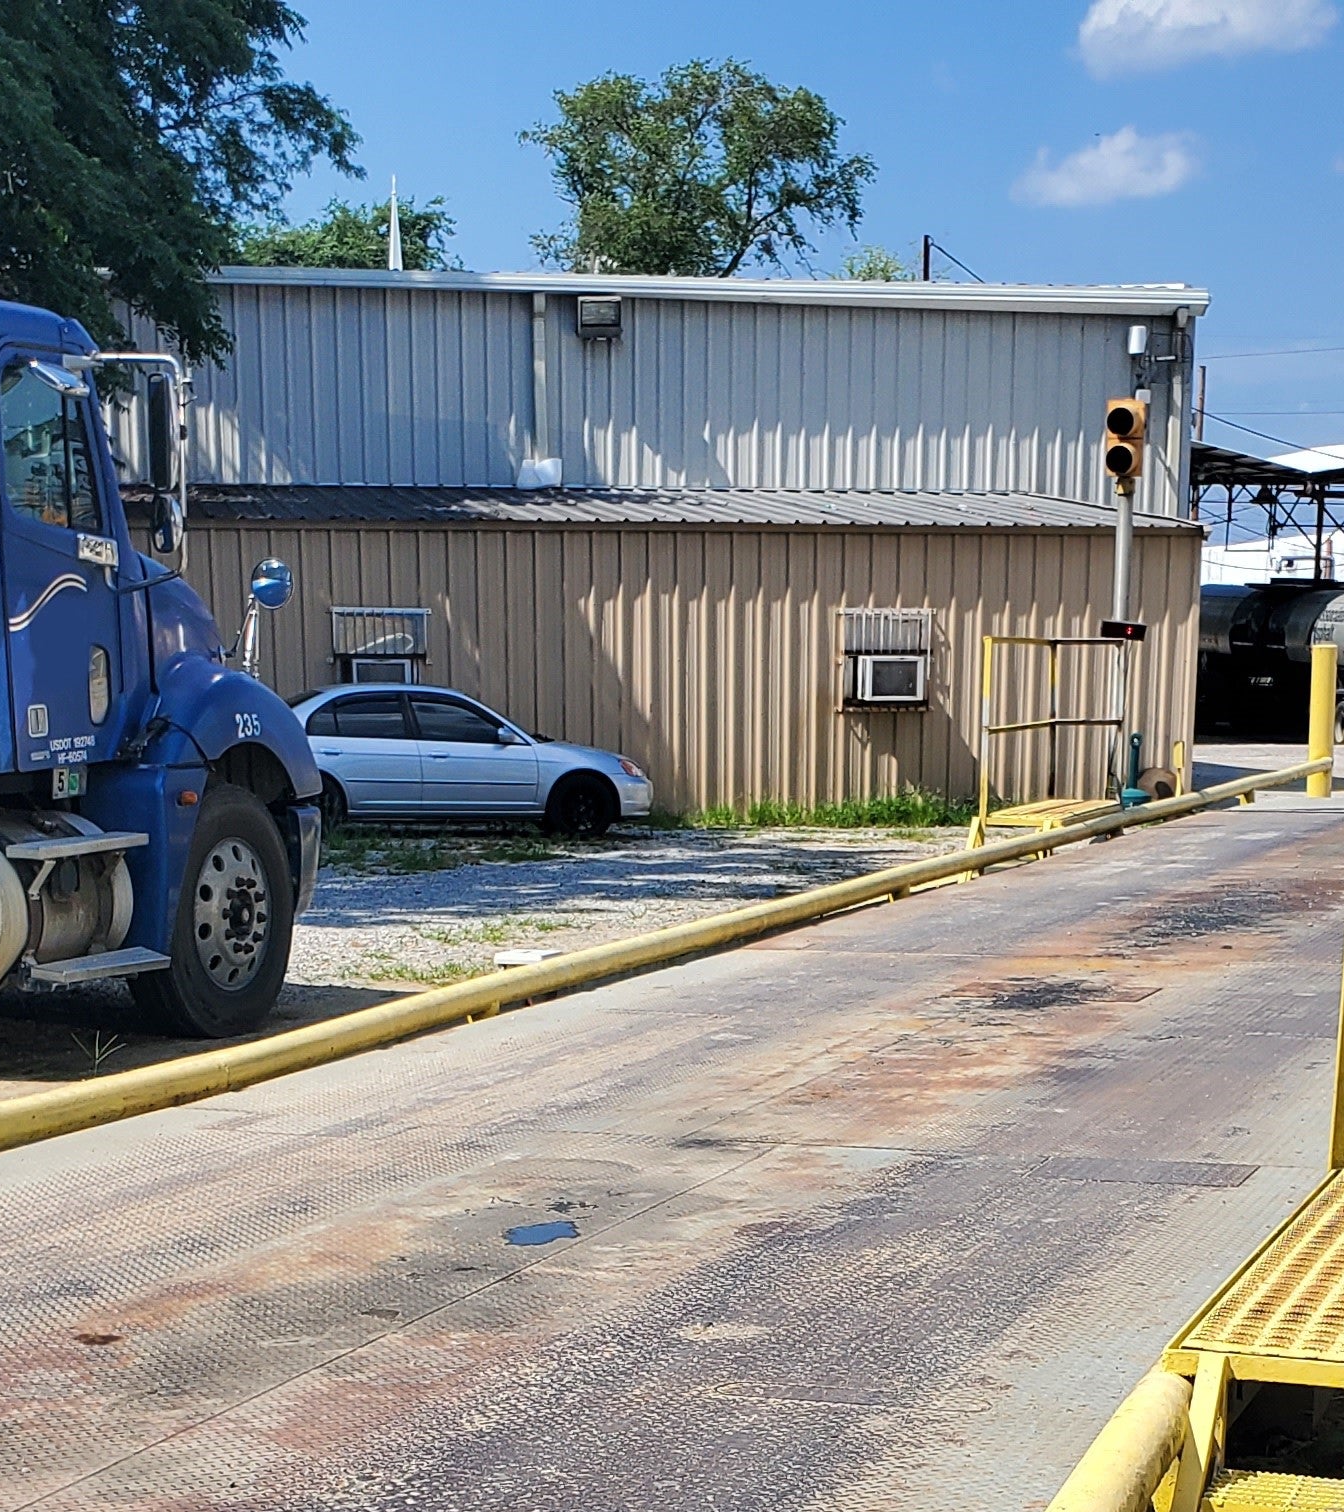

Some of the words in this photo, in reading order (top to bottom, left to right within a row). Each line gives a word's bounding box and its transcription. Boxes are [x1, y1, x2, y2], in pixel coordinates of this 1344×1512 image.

[235, 713, 261, 739] 235
[50, 737, 72, 752] USDOT
[57, 771, 65, 793] 5
